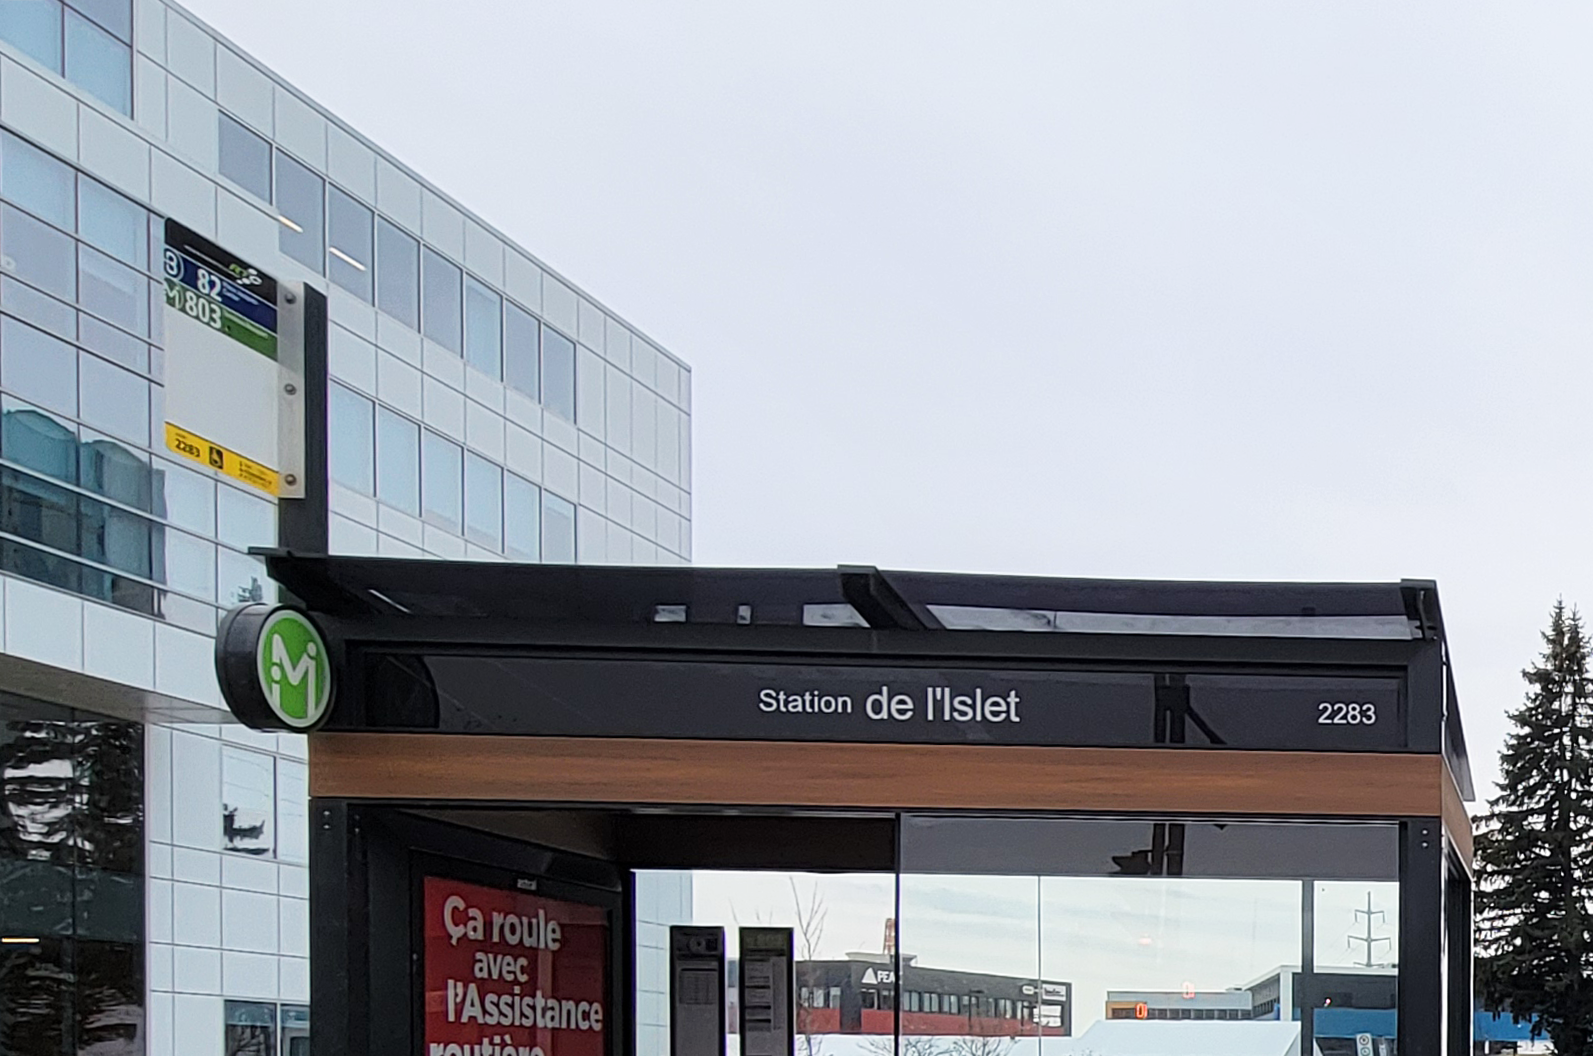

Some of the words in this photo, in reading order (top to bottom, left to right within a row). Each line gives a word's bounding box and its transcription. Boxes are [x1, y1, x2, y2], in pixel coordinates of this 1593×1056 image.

[197, 268, 222, 302] 82
[185, 291, 221, 329] 803
[175, 438, 200, 458] 2283
[758, 689, 852, 713] Station
[865, 686, 914, 720] de
[926, 686, 1020, 722] l'Islet
[1318, 703, 1376, 724] 2283
[443, 895, 484, 946] Ça
[491, 908, 562, 950] roule
[473, 950, 530, 983] avec
[446, 978, 603, 1031] l'Assistance
